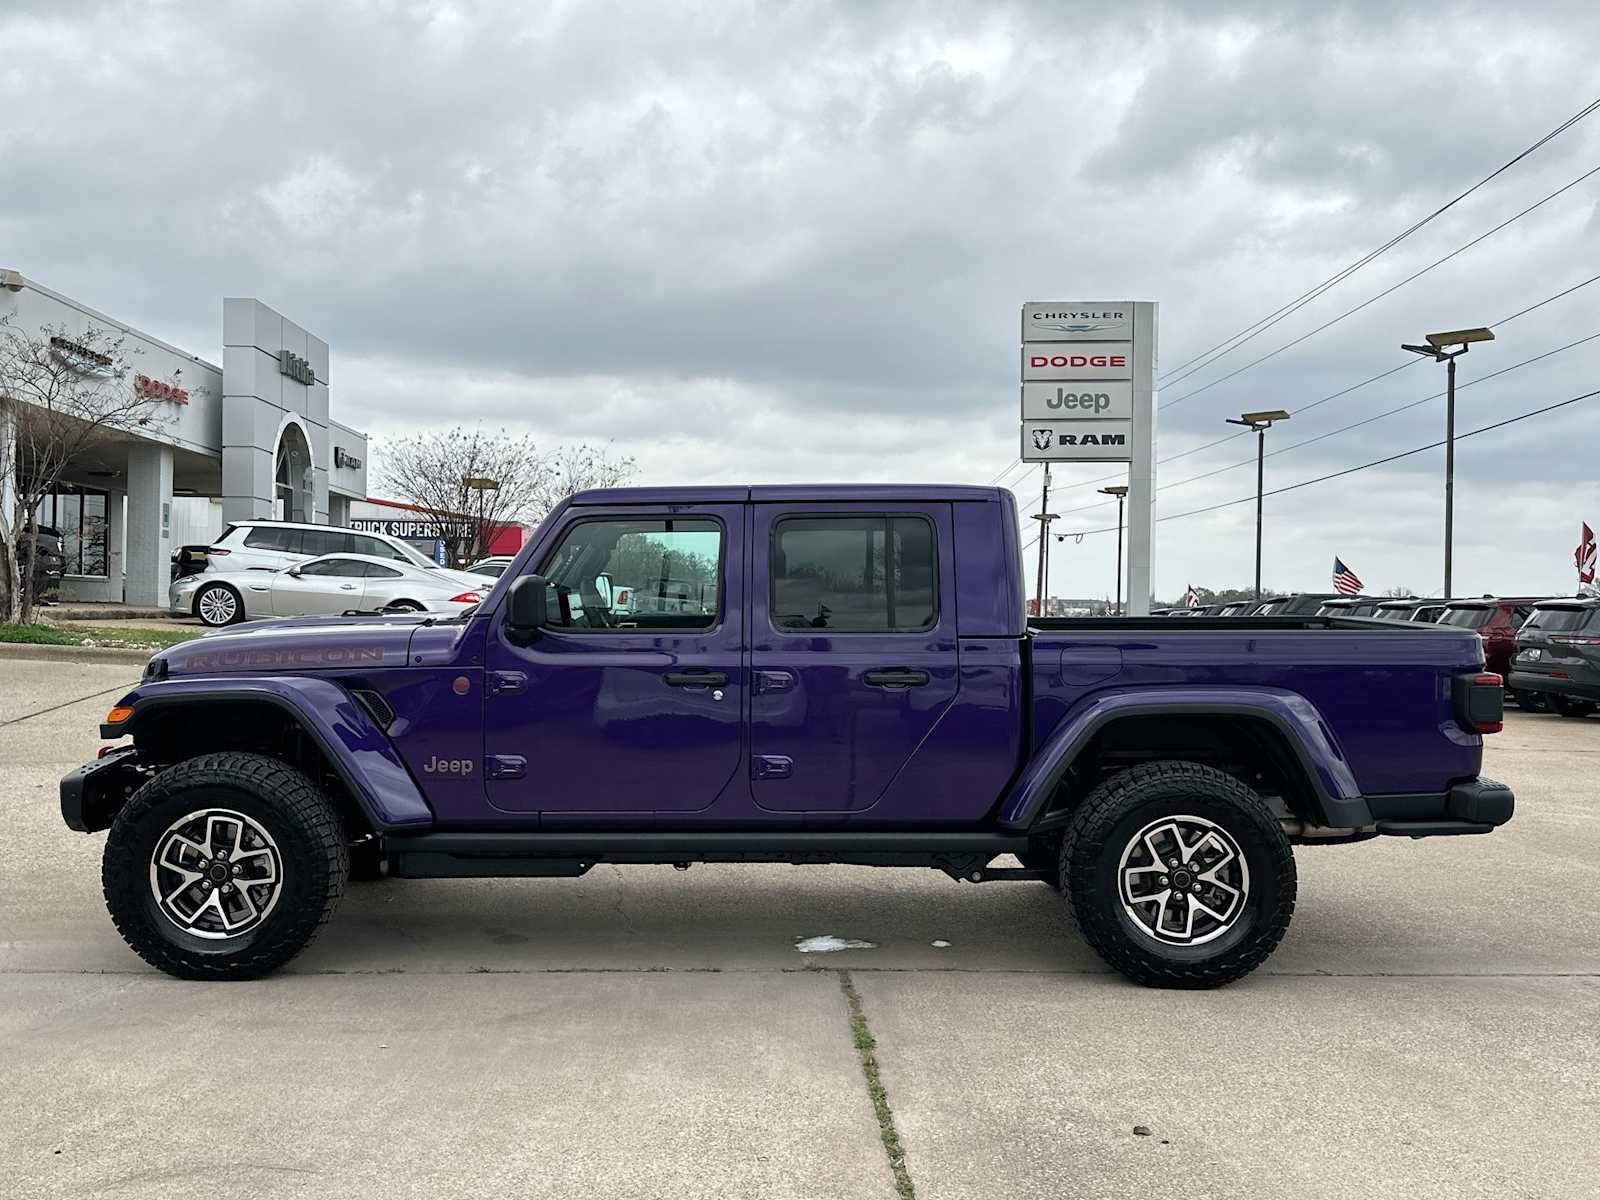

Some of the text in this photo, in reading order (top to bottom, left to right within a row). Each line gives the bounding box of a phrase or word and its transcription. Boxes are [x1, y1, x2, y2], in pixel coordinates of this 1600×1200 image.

[1032, 312, 1124, 320] CHRYSLER
[1031, 356, 1126, 368] DODGE
[1046, 387, 1111, 414] Jeep
[1059, 434, 1126, 446] RAM
[185, 647, 385, 670] RUBICON
[423, 756, 474, 776] Jeep
